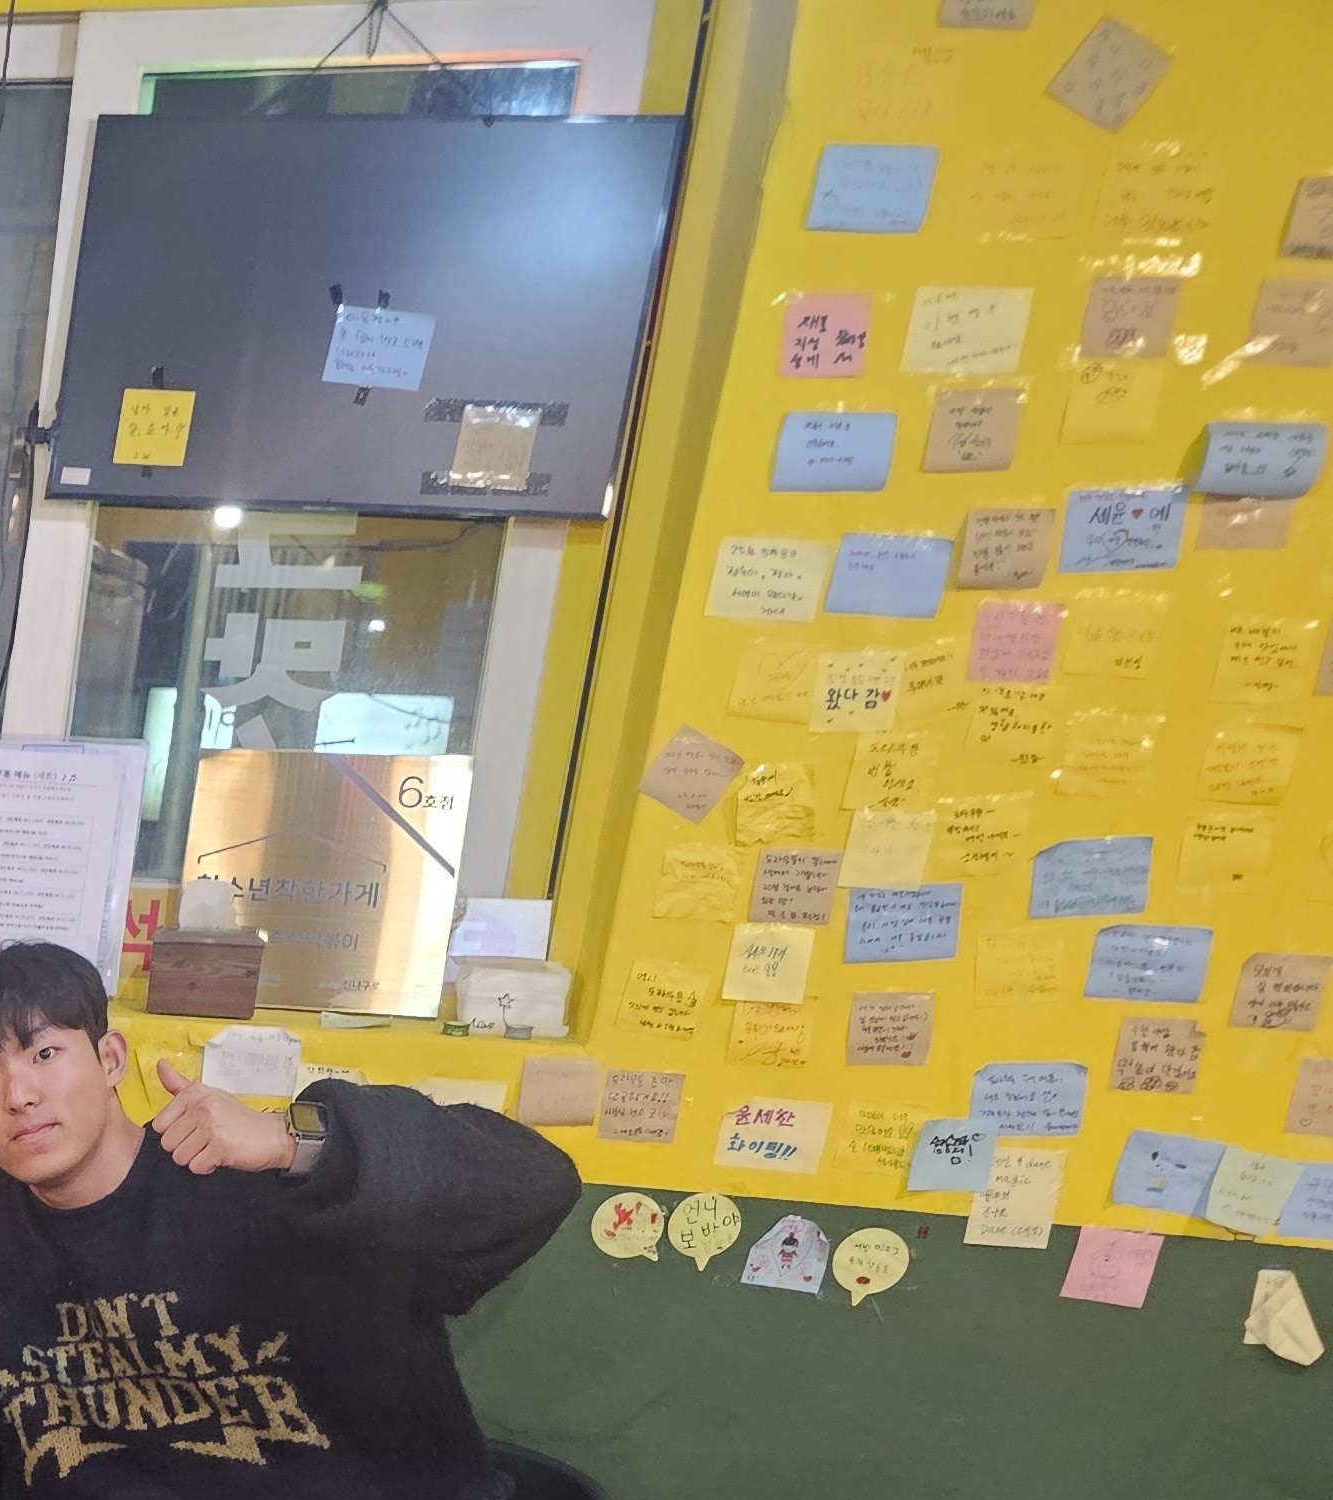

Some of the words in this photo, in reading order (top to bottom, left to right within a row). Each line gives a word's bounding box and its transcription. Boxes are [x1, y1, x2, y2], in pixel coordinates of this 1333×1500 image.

[397, 775, 454, 812] 6호점
[197, 873, 380, 909] 년착한가게
[735, 1104, 796, 1128] 윤세찬
[727, 1132, 798, 1160] 화이팅!!
[21, 1338, 164, 1387] STEAL
[154, 1323, 250, 1378] MY
[1, 1374, 332, 1464] THUNDER
